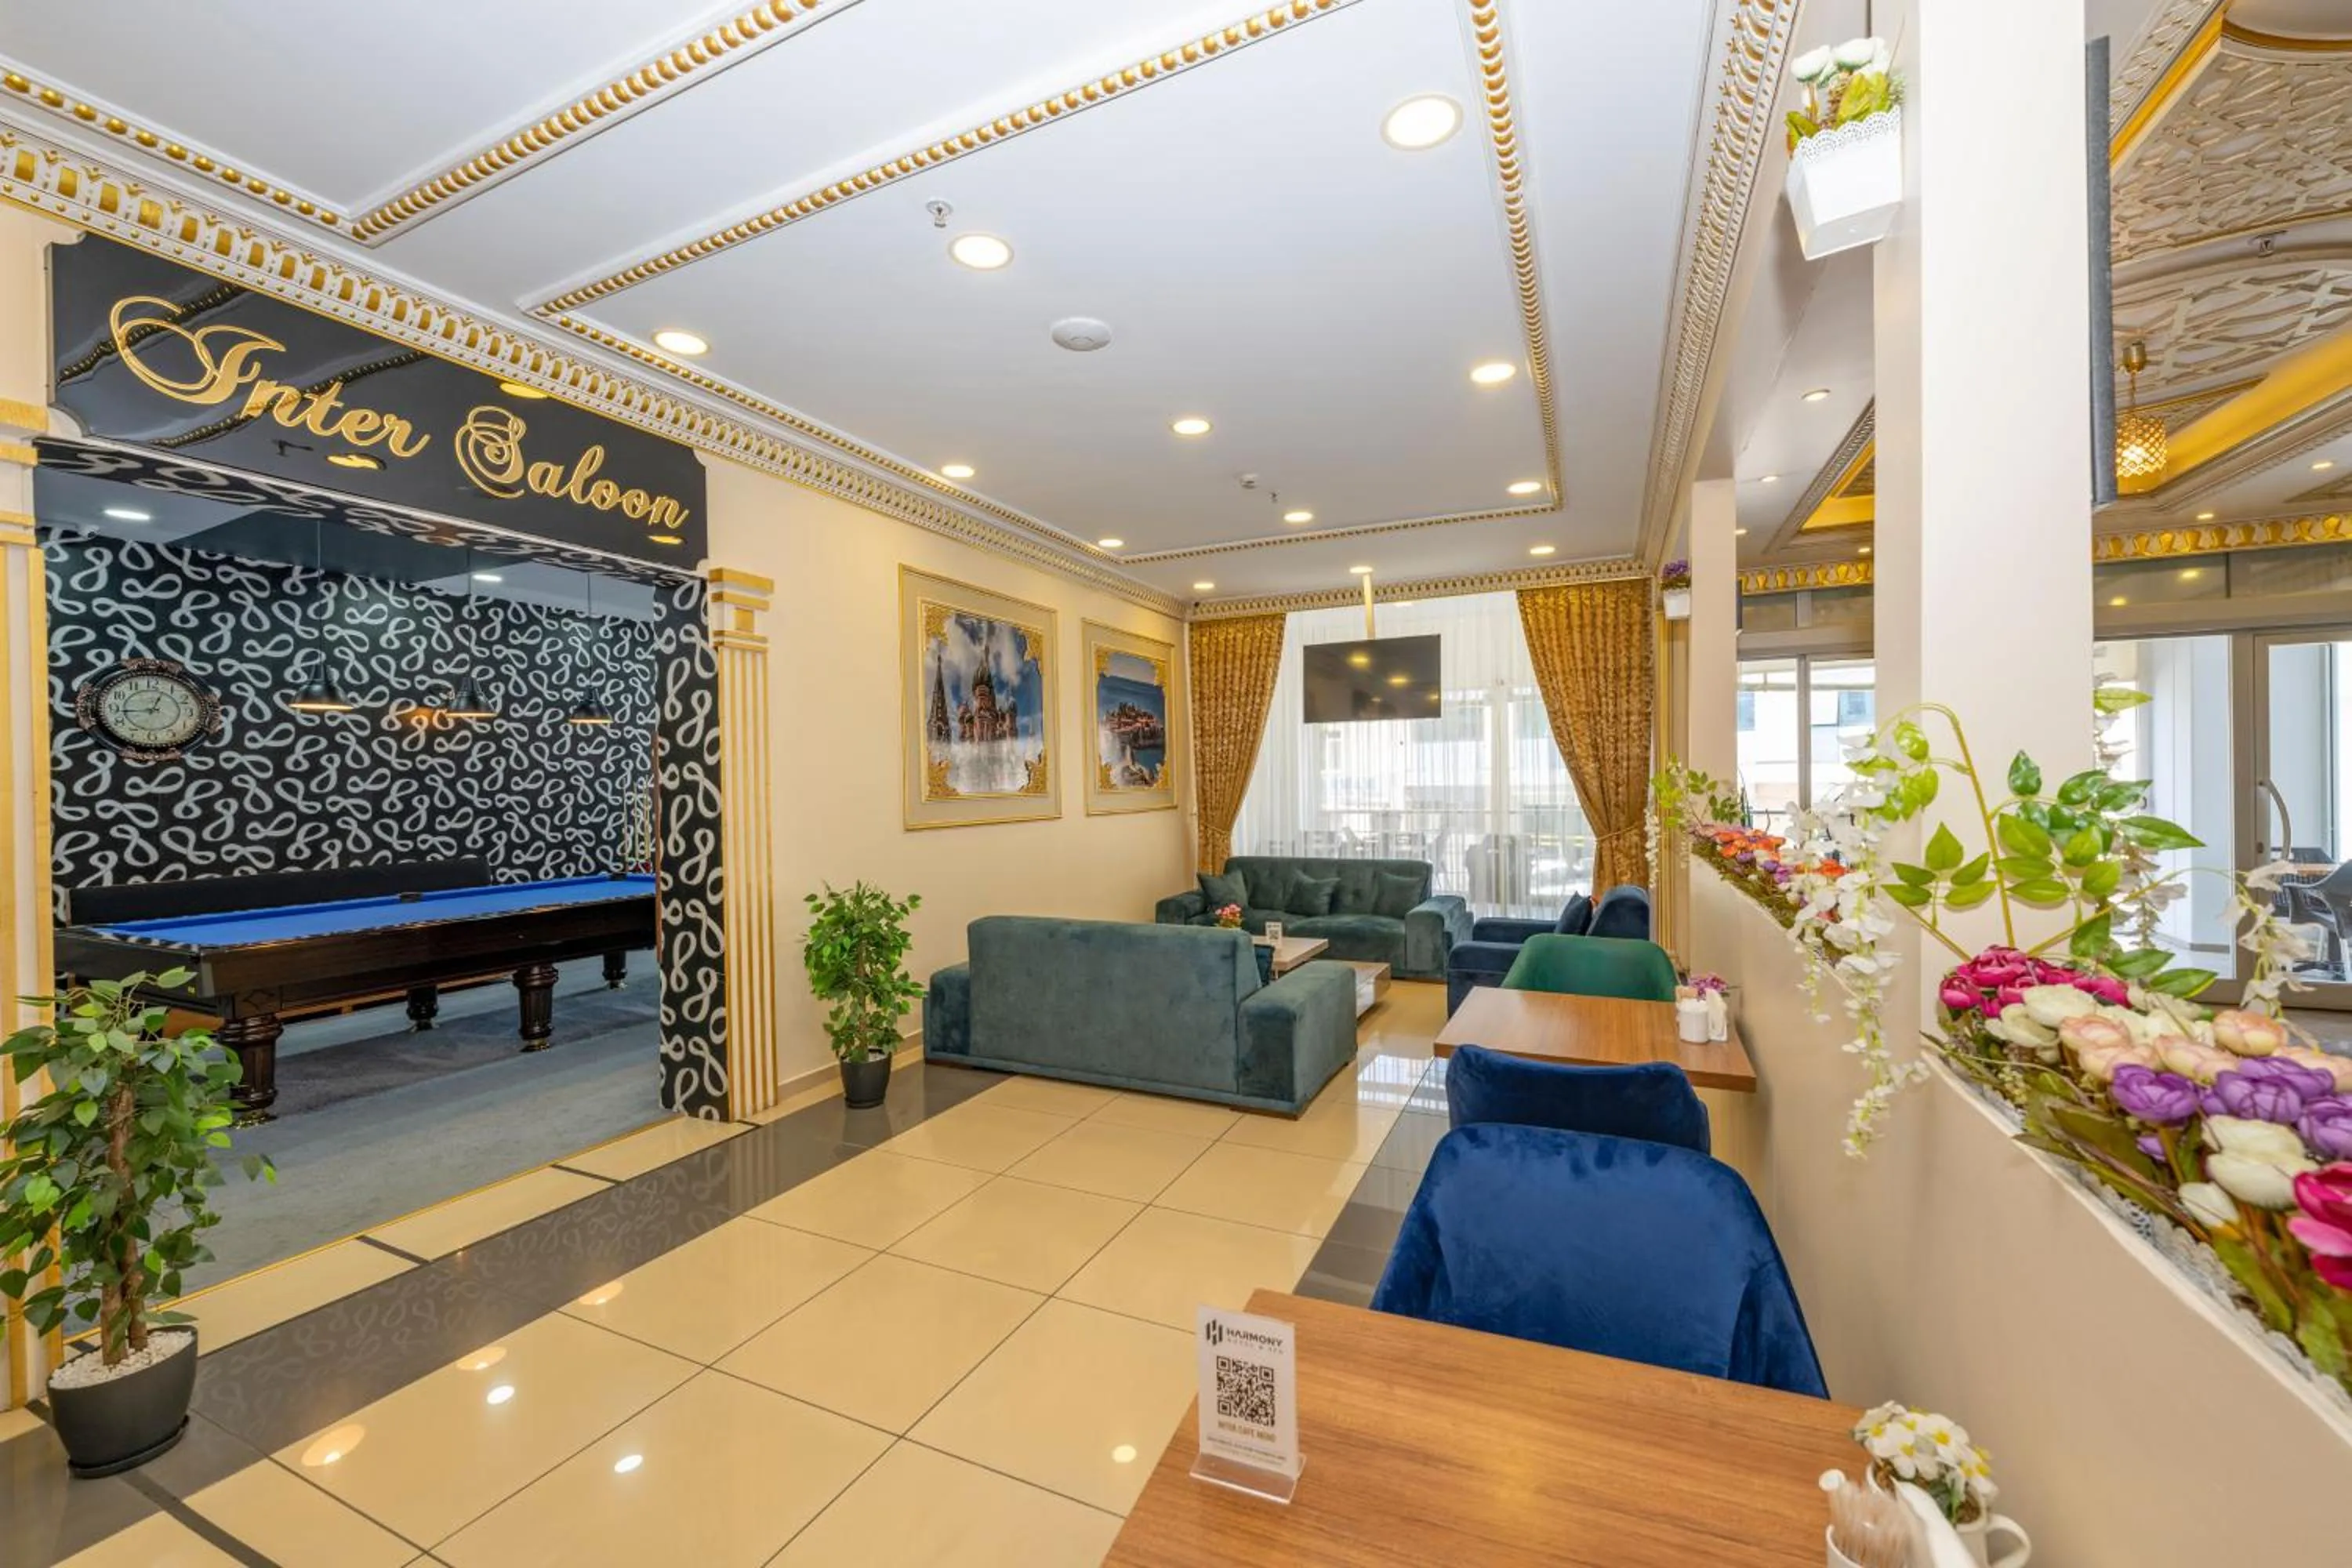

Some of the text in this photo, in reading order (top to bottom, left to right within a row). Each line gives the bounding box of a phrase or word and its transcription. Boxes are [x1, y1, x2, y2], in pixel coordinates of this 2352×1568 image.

[109, 295, 690, 529] Inter Saloon
[129, 681, 139, 691] 11
[147, 680, 159, 689] 12
[114, 691, 125, 700] 10
[180, 695, 189, 705] 2
[147, 731, 158, 742] 6
[1226, 1328, 1283, 1346] HARMONY
